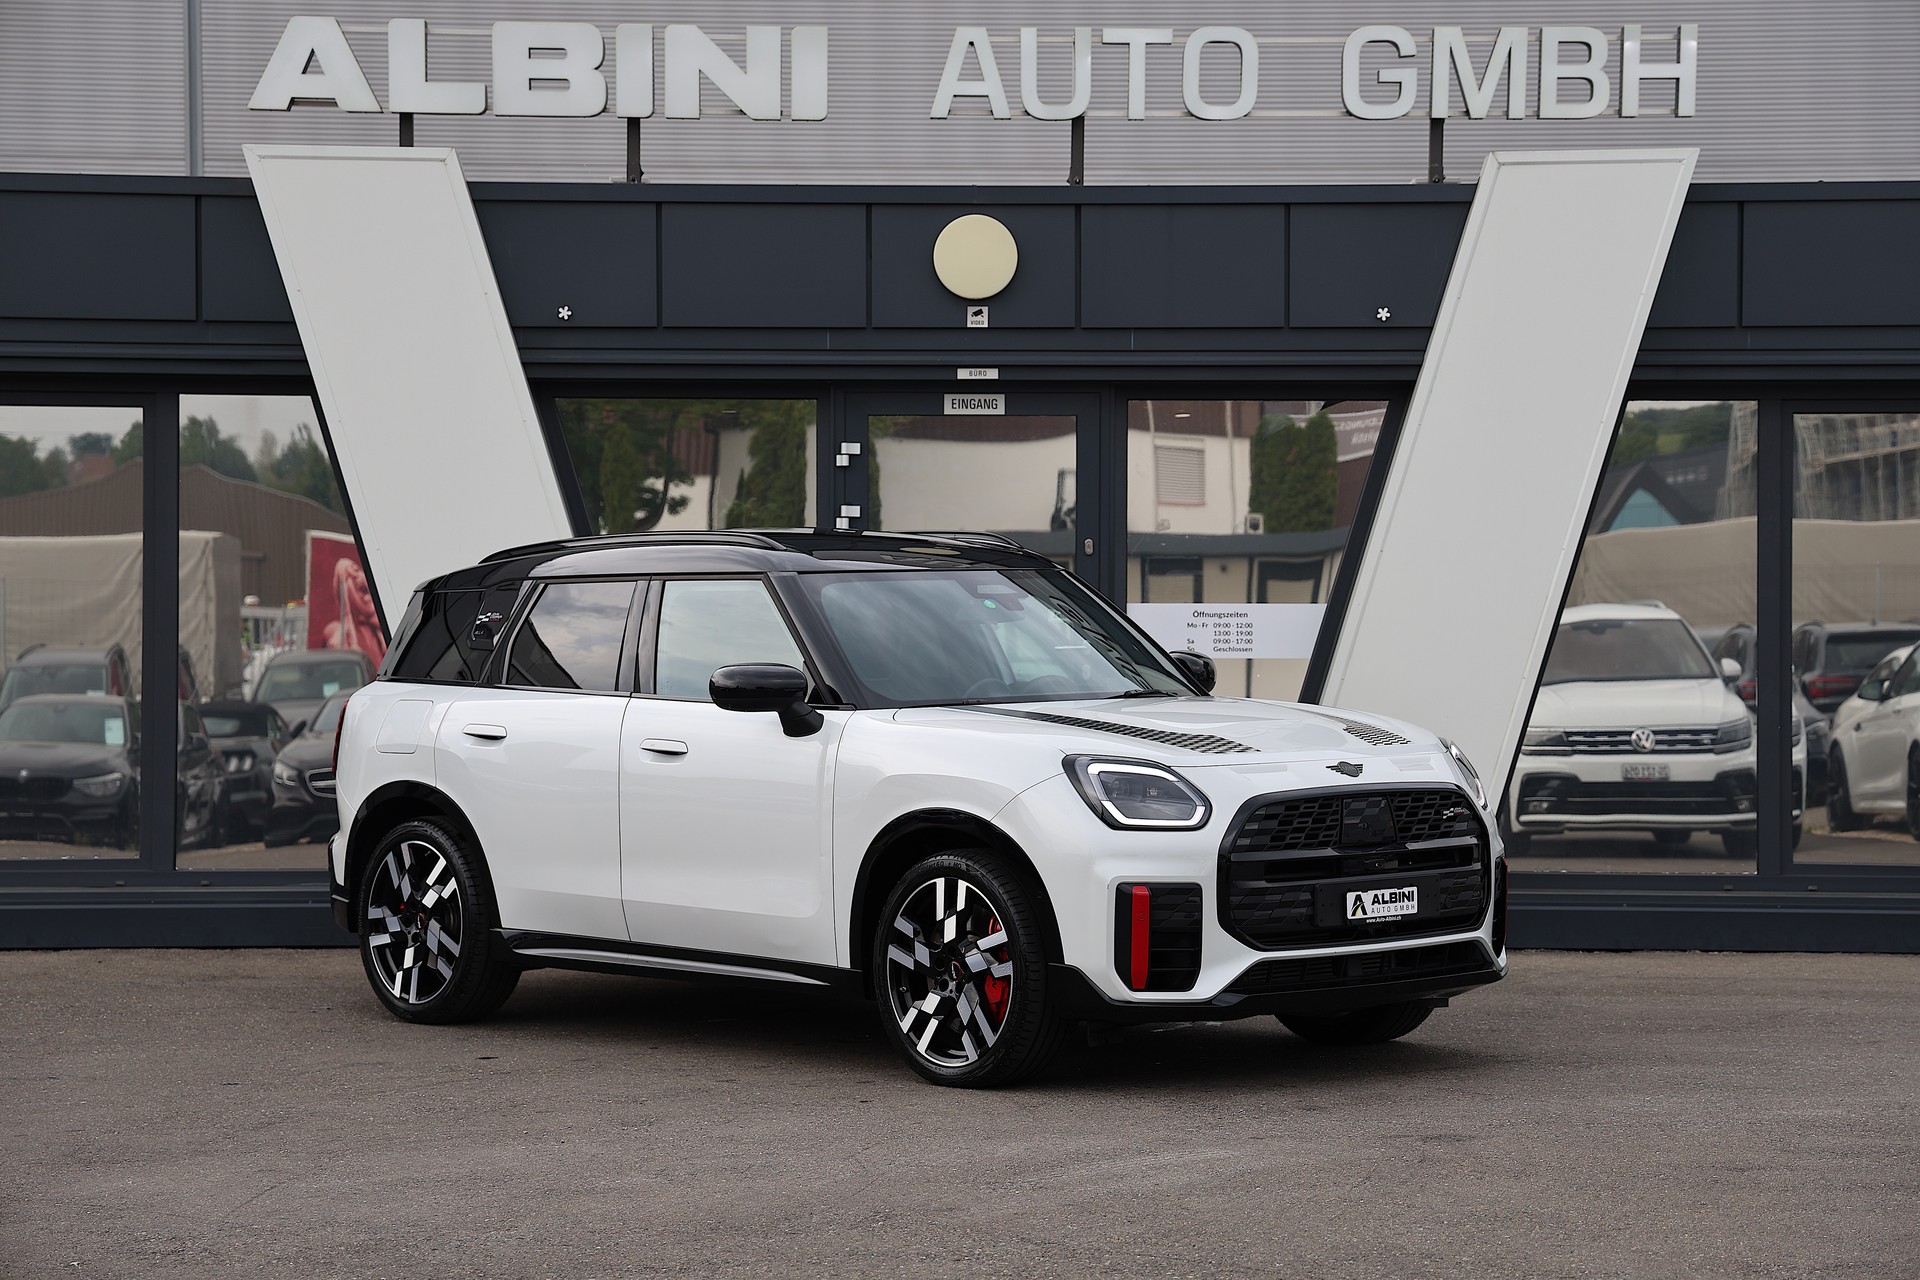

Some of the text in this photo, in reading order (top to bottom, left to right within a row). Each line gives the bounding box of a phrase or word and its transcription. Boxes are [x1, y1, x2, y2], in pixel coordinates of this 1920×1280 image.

[248, 16, 1699, 121] ALBINI AUTO GMBH
[951, 398, 998, 410] EINGANG
[1192, 610, 1248, 619] Öffnungszeiten
[1371, 890, 1414, 905] ALBINI
[1394, 904, 1415, 912] GMBH
